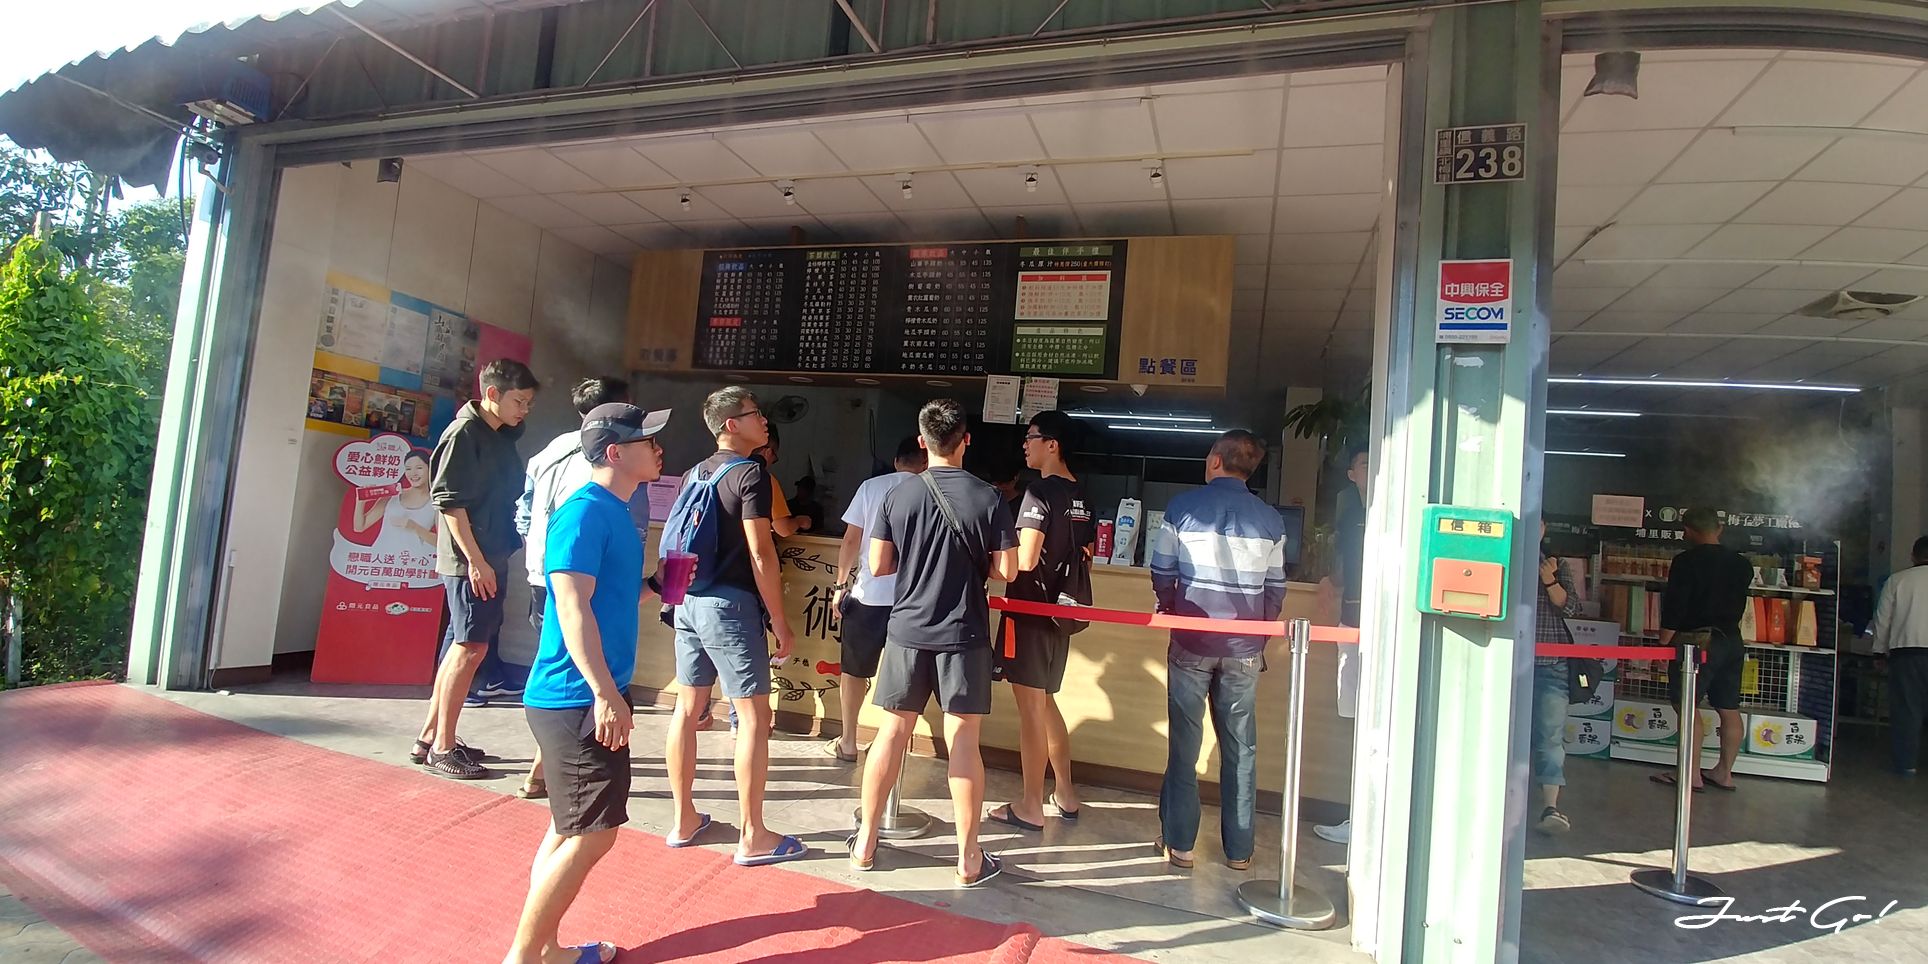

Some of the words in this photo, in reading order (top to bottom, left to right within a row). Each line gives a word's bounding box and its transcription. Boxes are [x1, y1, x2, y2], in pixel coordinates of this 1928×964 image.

[1457, 128, 1521, 144] 信義路
[1456, 146, 1521, 178] 238
[1445, 282, 1504, 297] 中興保全
[1445, 307, 1504, 320] SECOM
[1139, 358, 1197, 375] 點餐區
[347, 451, 400, 466] 愛心鮮奶
[345, 465, 399, 478] 公益夥伴
[1451, 520, 1492, 533] 信箱
[1636, 529, 1684, 540] 埔里販賣
